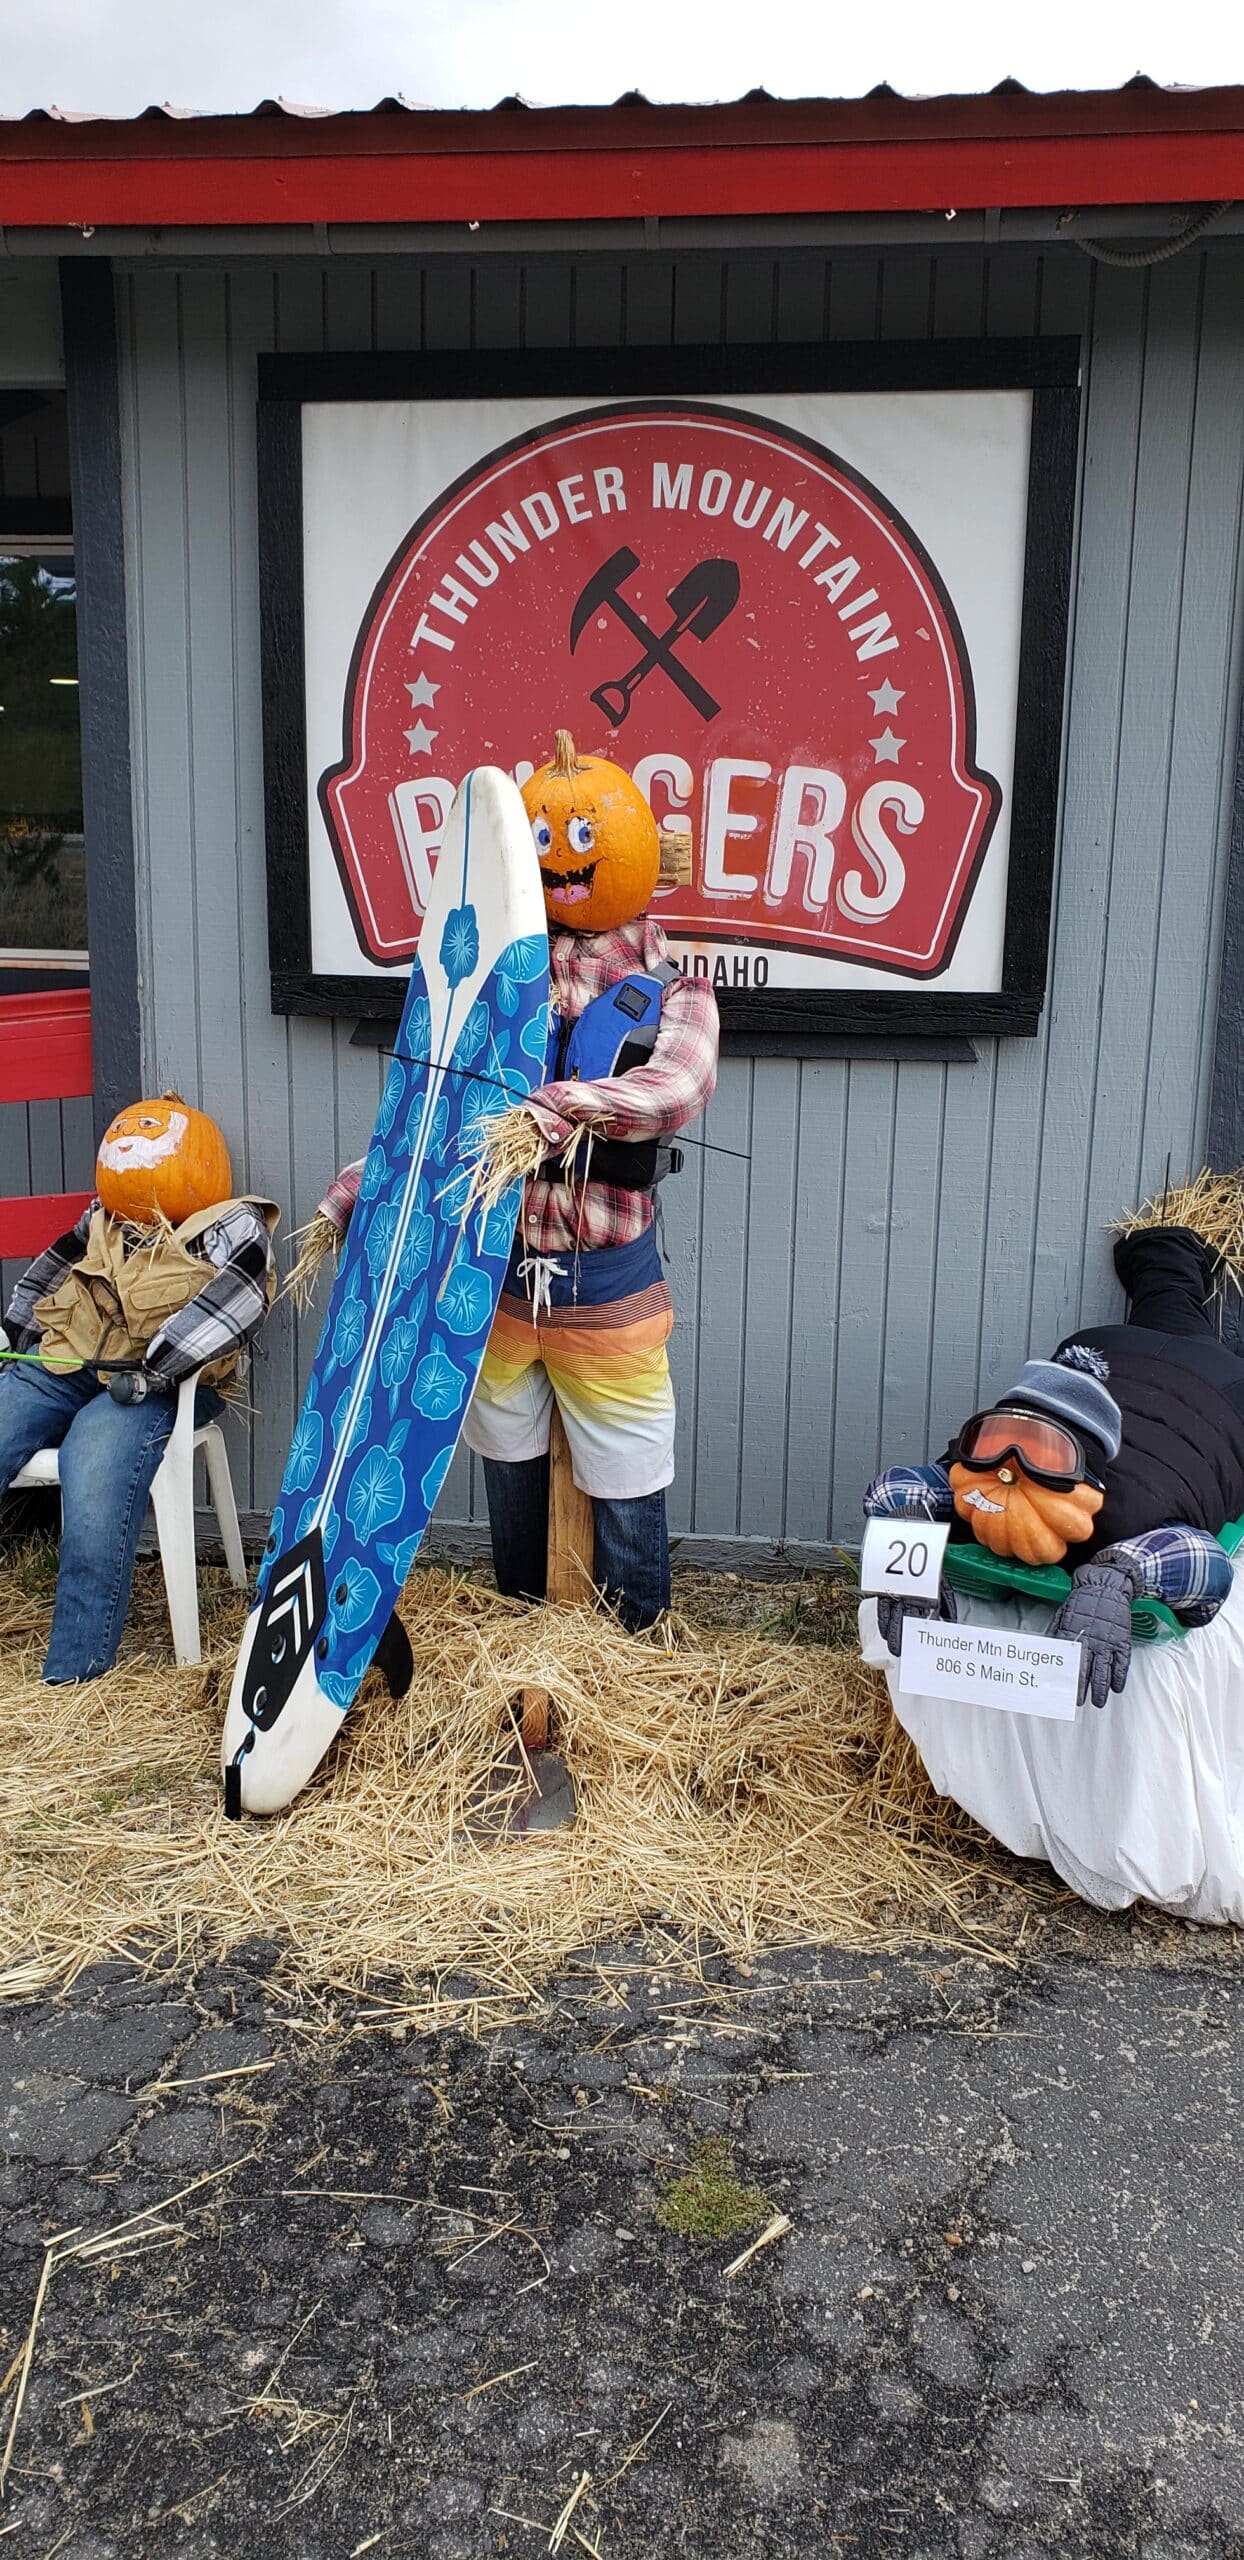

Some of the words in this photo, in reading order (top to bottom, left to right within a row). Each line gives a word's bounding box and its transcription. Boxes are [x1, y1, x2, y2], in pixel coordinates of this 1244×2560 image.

[411, 466, 627, 652] THUNDER
[652, 462, 899, 663] MOUNTAIN
[389, 753, 925, 925] BGERS
[682, 955, 769, 987] IDAHO
[885, 1540, 928, 1577] 20
[917, 1630, 973, 1652] Thunder
[977, 1639, 1002, 1657] Mtn
[1006, 1644, 1064, 1667] Burgers
[936, 1657, 961, 1674] 806
[966, 1662, 976, 1677] S
[980, 1666, 1014, 1683] Main
[1018, 1671, 1038, 1688] St.
